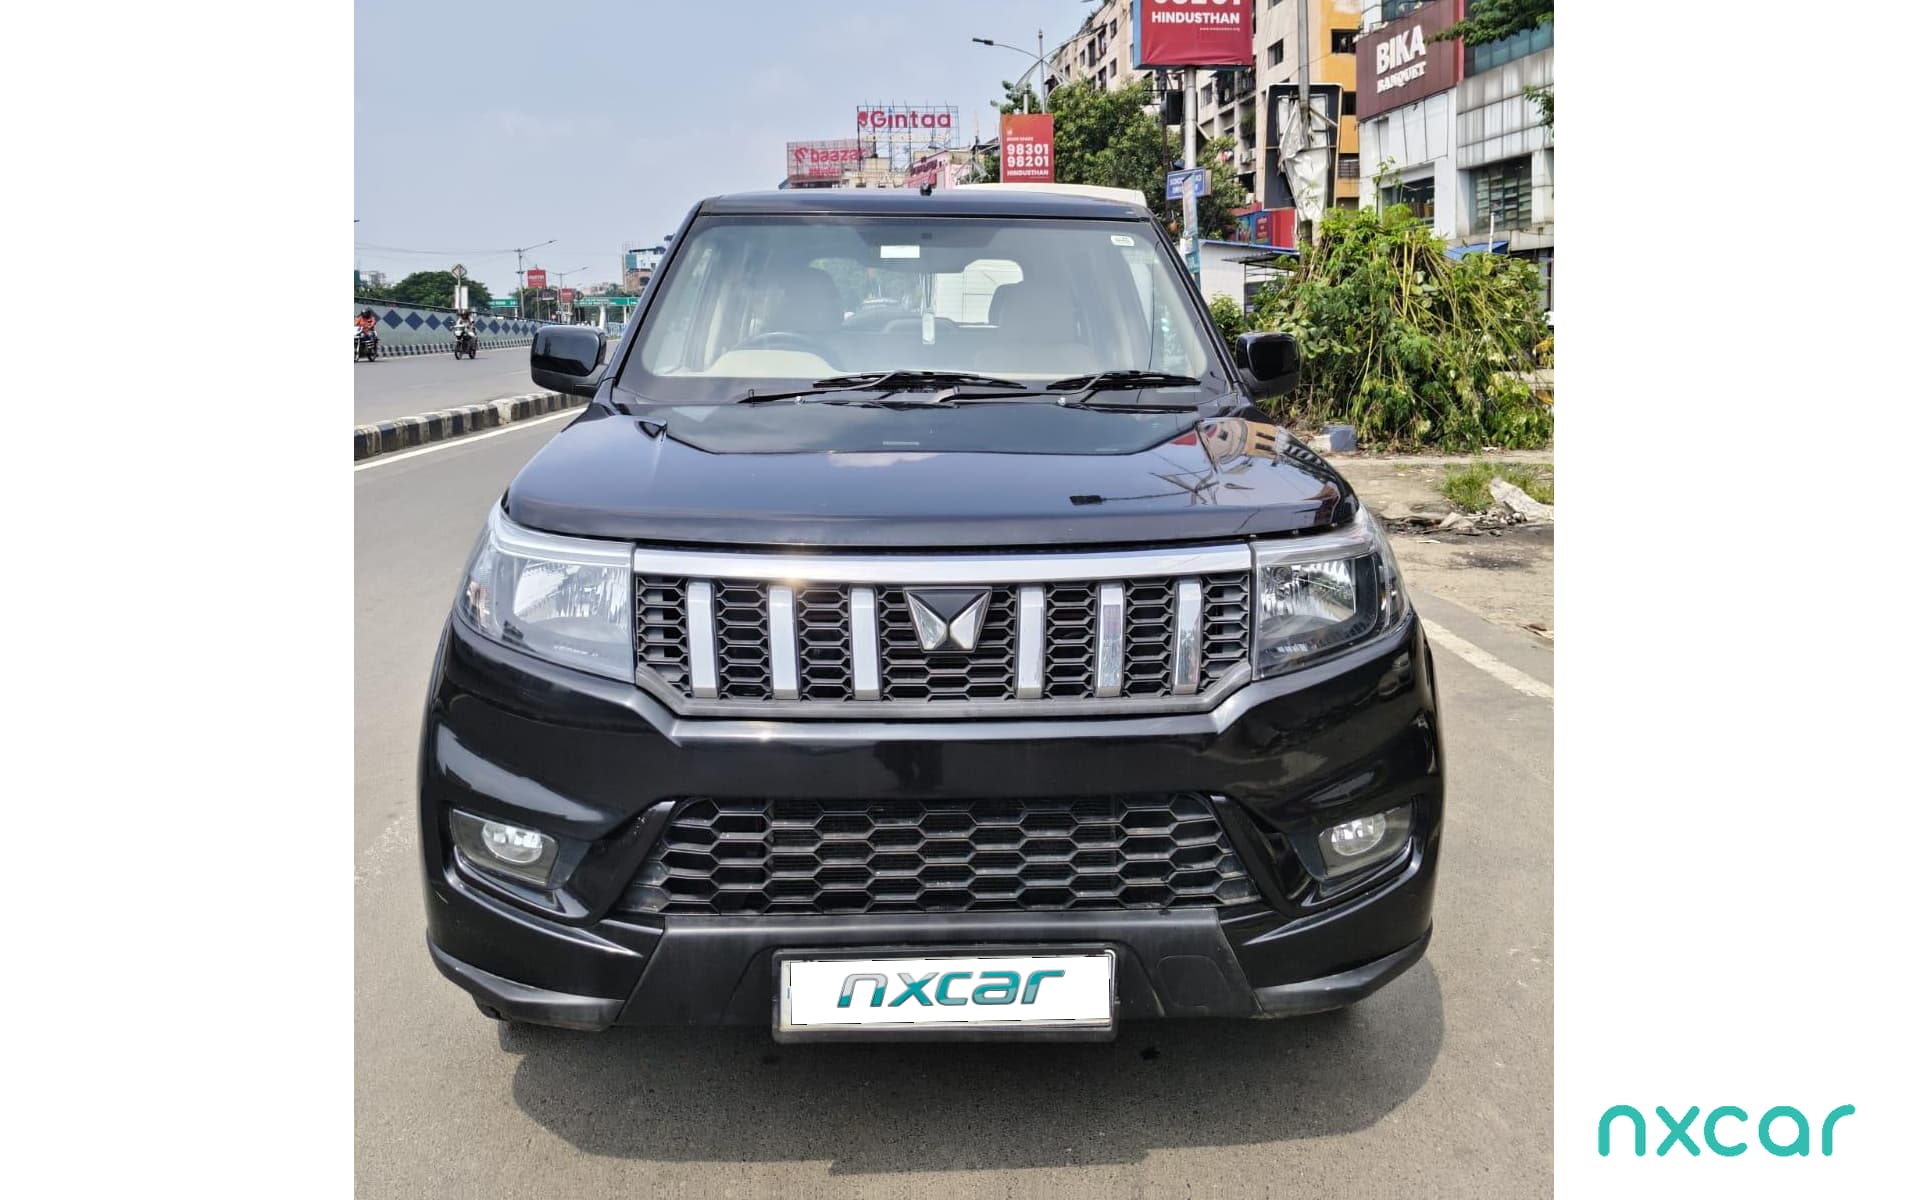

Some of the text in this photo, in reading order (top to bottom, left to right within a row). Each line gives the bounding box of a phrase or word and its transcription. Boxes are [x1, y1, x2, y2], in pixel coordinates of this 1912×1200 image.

[1151, 11, 1240, 25] HINDUSTHAN
[1376, 24, 1427, 75] BIKA
[1376, 61, 1427, 94] BANQUET
[870, 110, 951, 128] Gintaa
[1006, 143, 1049, 155] 98301
[1006, 155, 1049, 167] 98201
